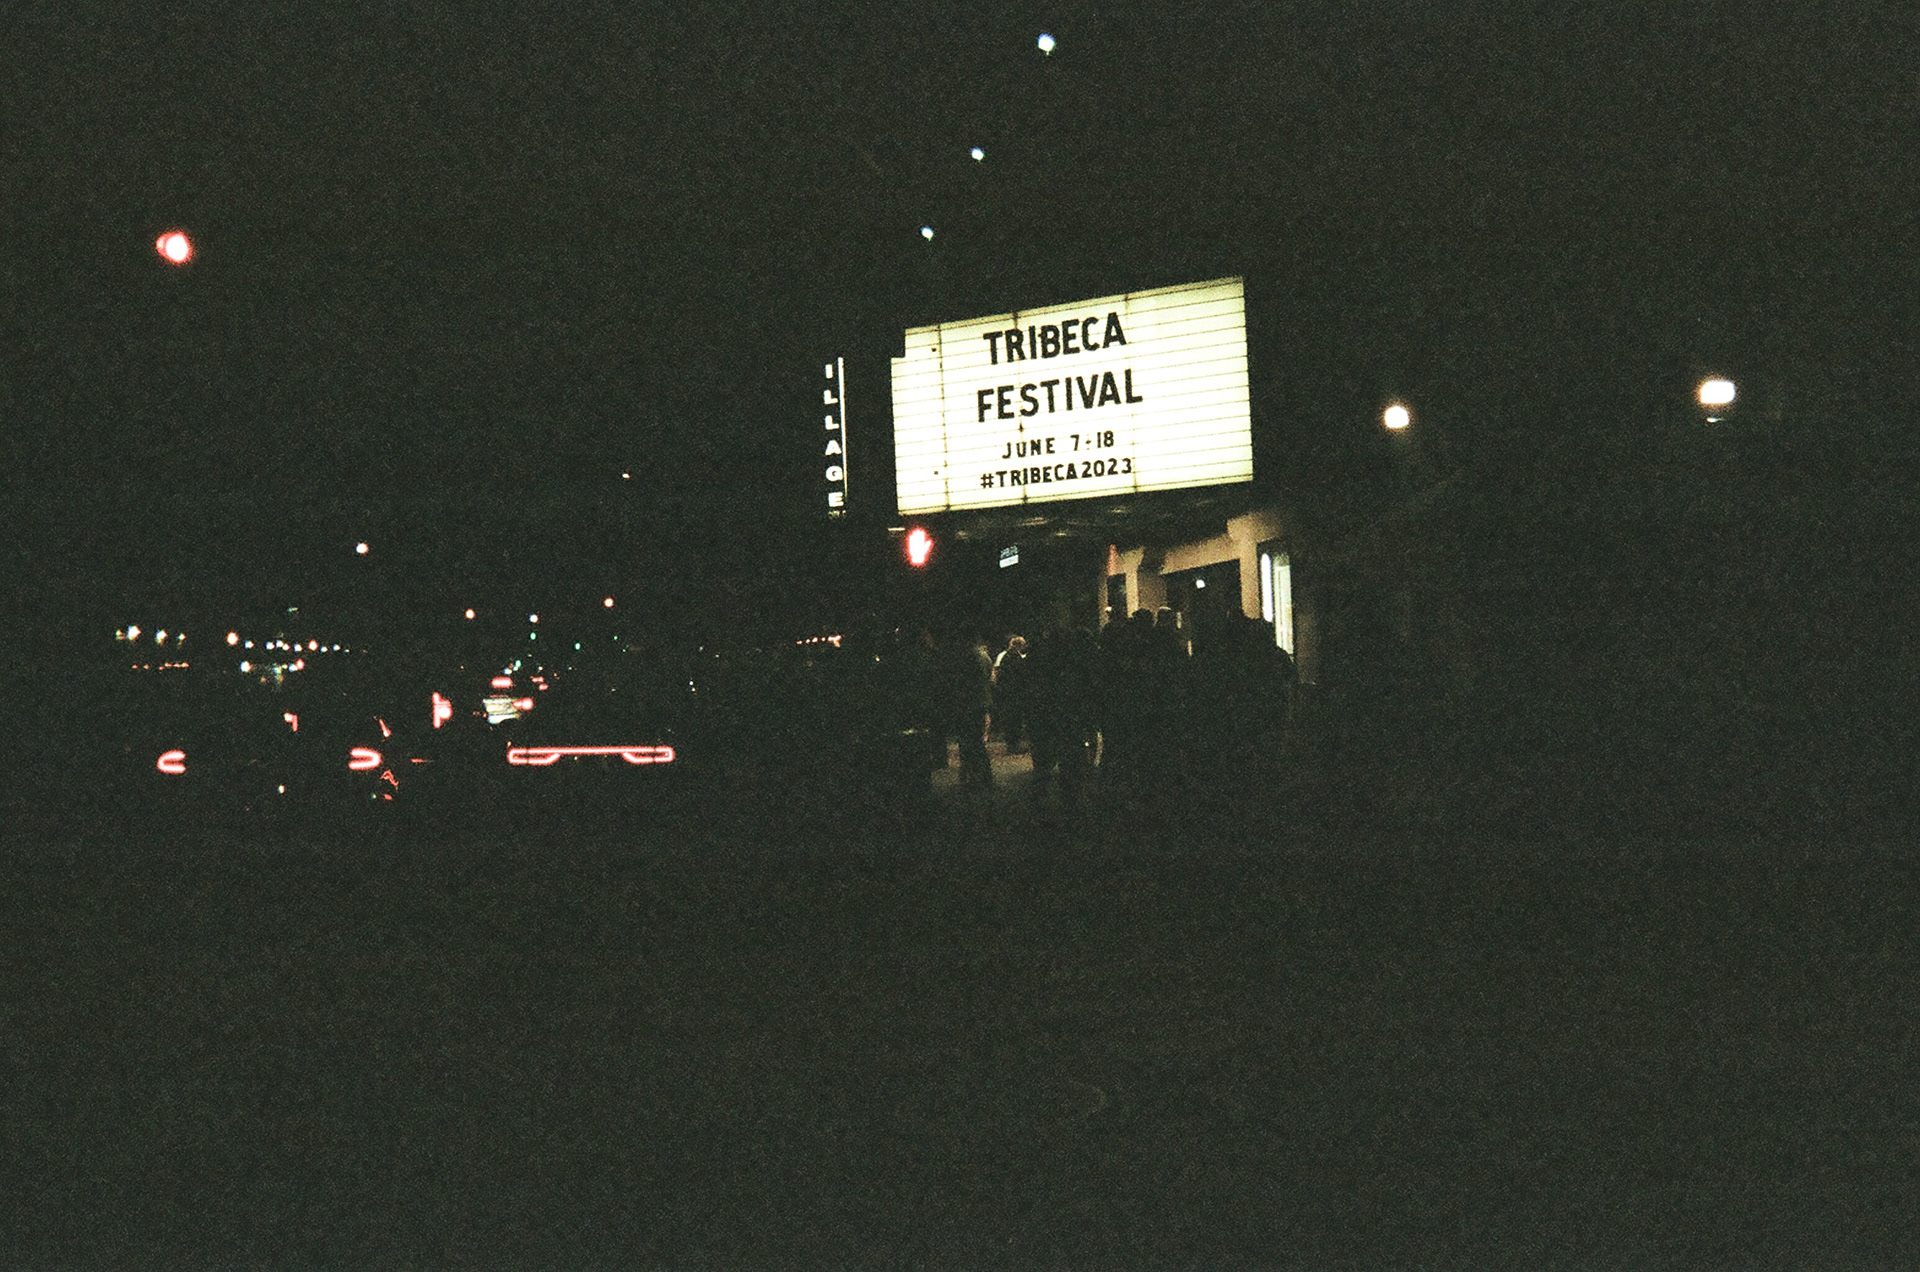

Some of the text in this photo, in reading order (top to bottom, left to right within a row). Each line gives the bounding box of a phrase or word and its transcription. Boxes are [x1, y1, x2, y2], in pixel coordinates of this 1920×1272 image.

[983, 312, 1127, 365] TRIBECA
[977, 369, 1143, 423] FESTIVAL
[1002, 437, 1056, 459] JUNE
[980, 457, 1132, 489] #TRIBECA2023
